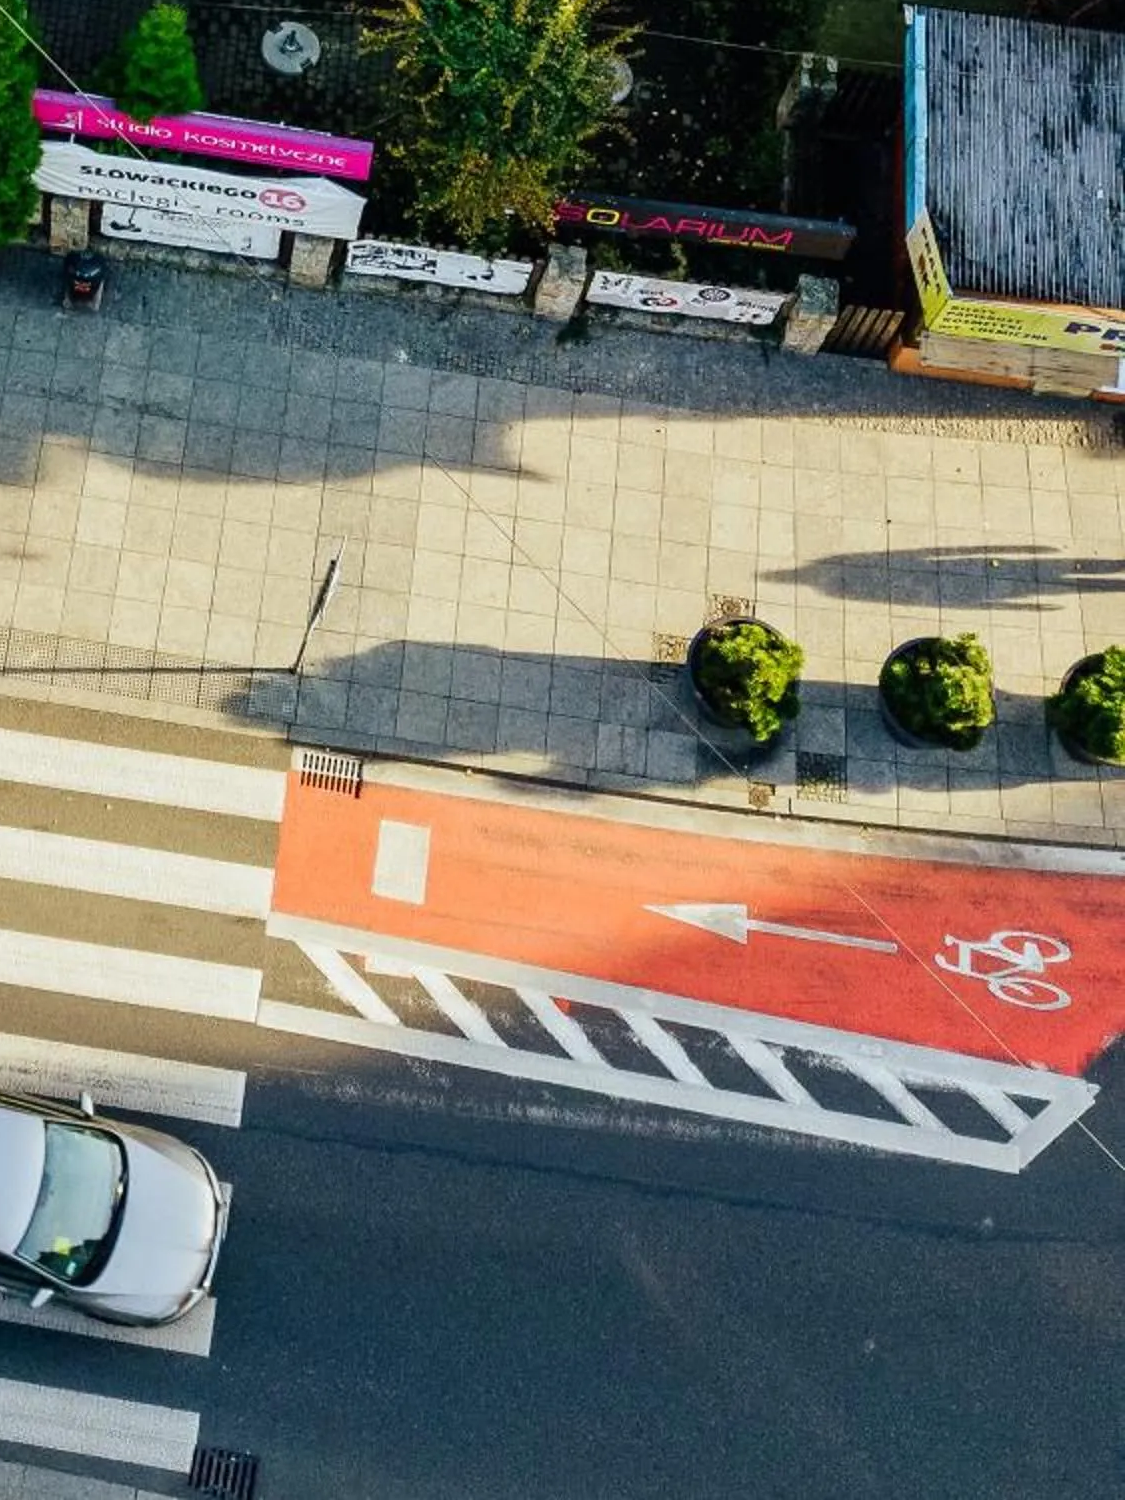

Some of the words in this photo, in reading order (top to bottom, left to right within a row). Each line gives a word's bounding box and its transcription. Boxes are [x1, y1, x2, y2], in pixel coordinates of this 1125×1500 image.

[264, 191, 301, 208] 16
[216, 207, 304, 227] rooms
[554, 203, 794, 246] SOLARIUM
